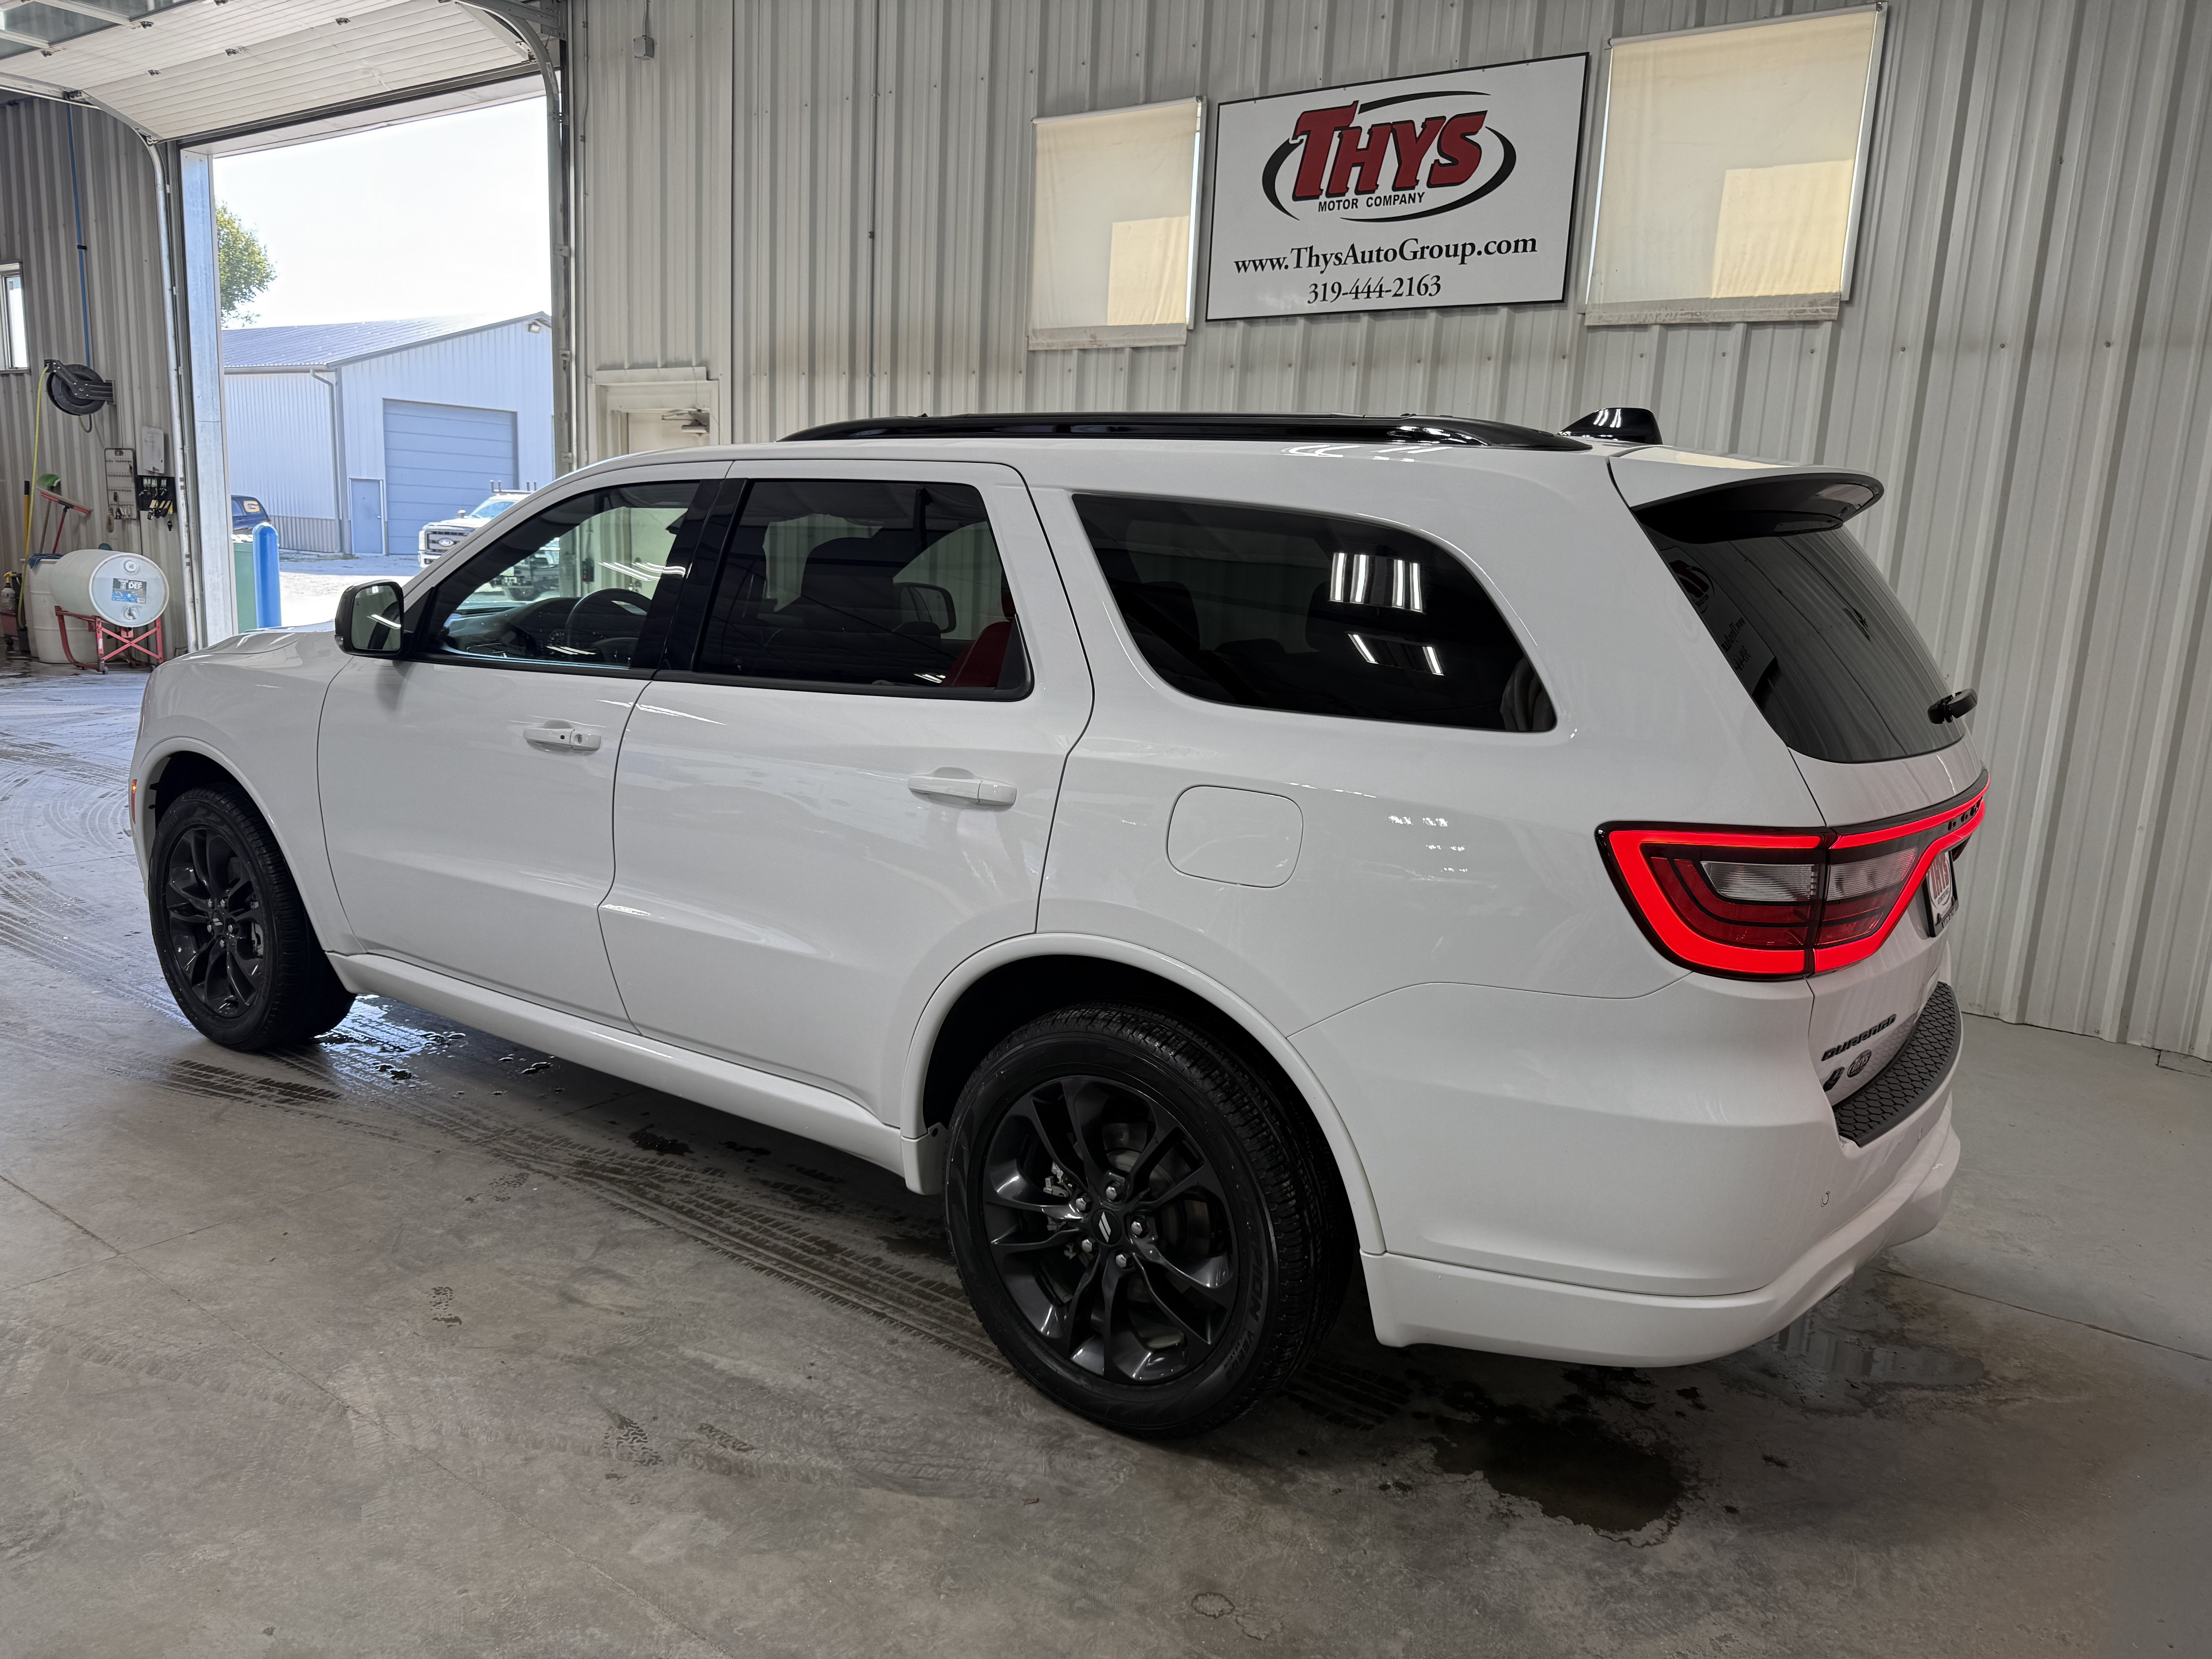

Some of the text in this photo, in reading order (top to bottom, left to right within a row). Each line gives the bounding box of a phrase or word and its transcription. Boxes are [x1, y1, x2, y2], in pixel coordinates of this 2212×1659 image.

[1292, 100, 1488, 201] THYS
[1318, 192, 1425, 212] MOTOR COMPANY
[1234, 238, 1537, 274] www.ThysAutoGroup.com
[1307, 274, 1441, 304] 319-444-2163
